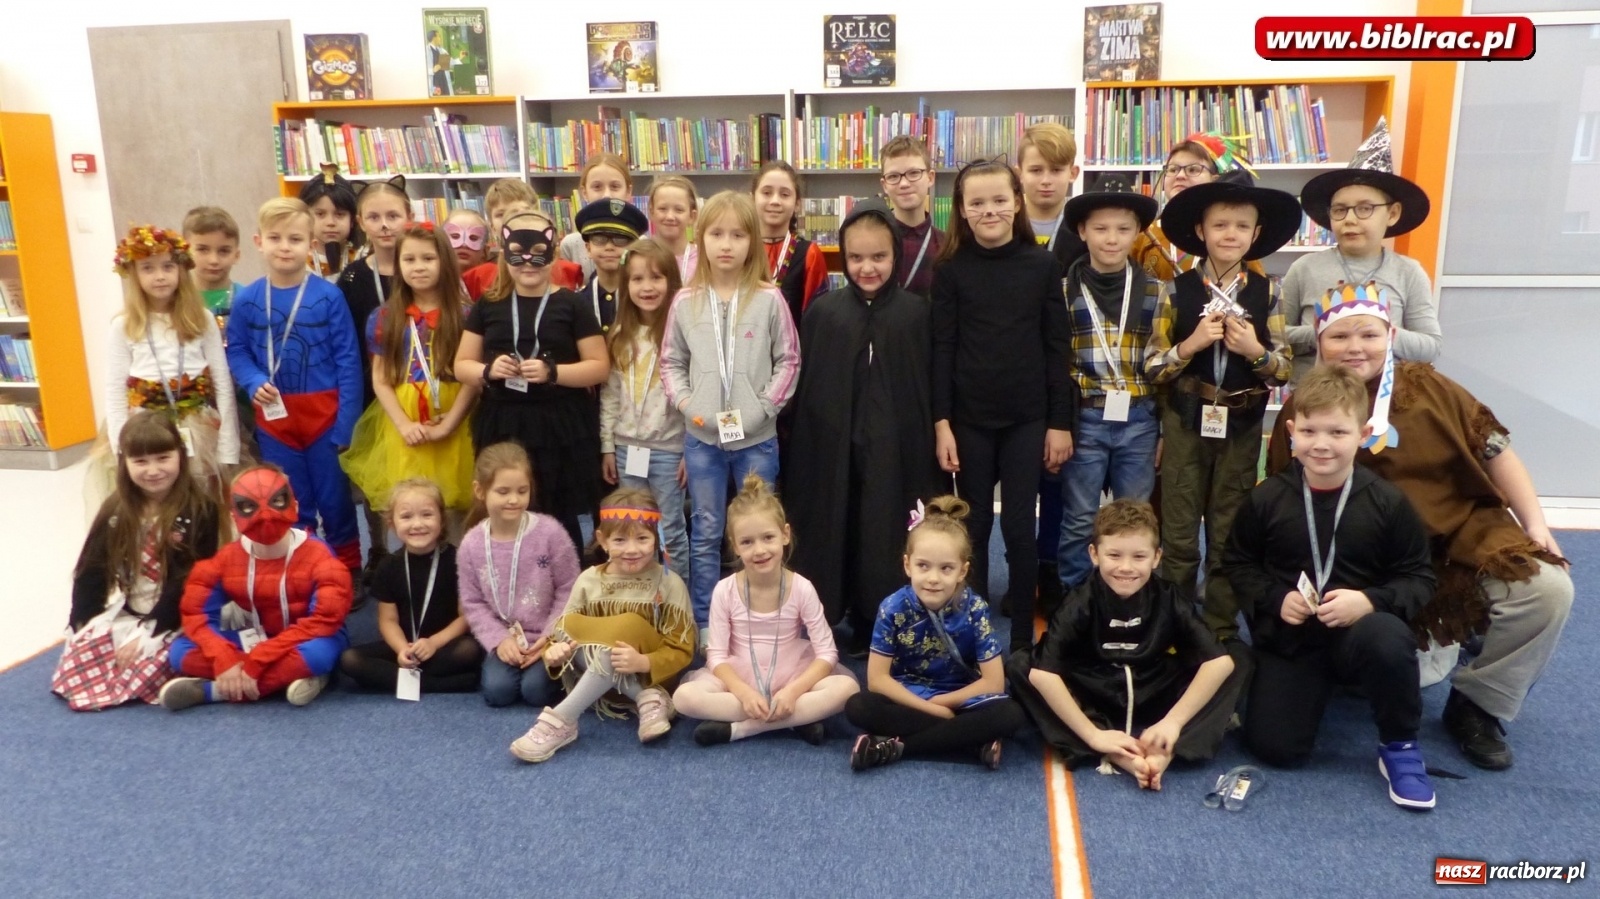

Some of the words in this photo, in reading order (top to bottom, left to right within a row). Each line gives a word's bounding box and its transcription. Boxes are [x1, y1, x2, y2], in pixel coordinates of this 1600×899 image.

[829, 21, 891, 44] RELIC
[1099, 19, 1144, 37] MARTWA
[1100, 36, 1141, 60] ZIMA
[600, 581, 653, 593] POCAHONTAS
